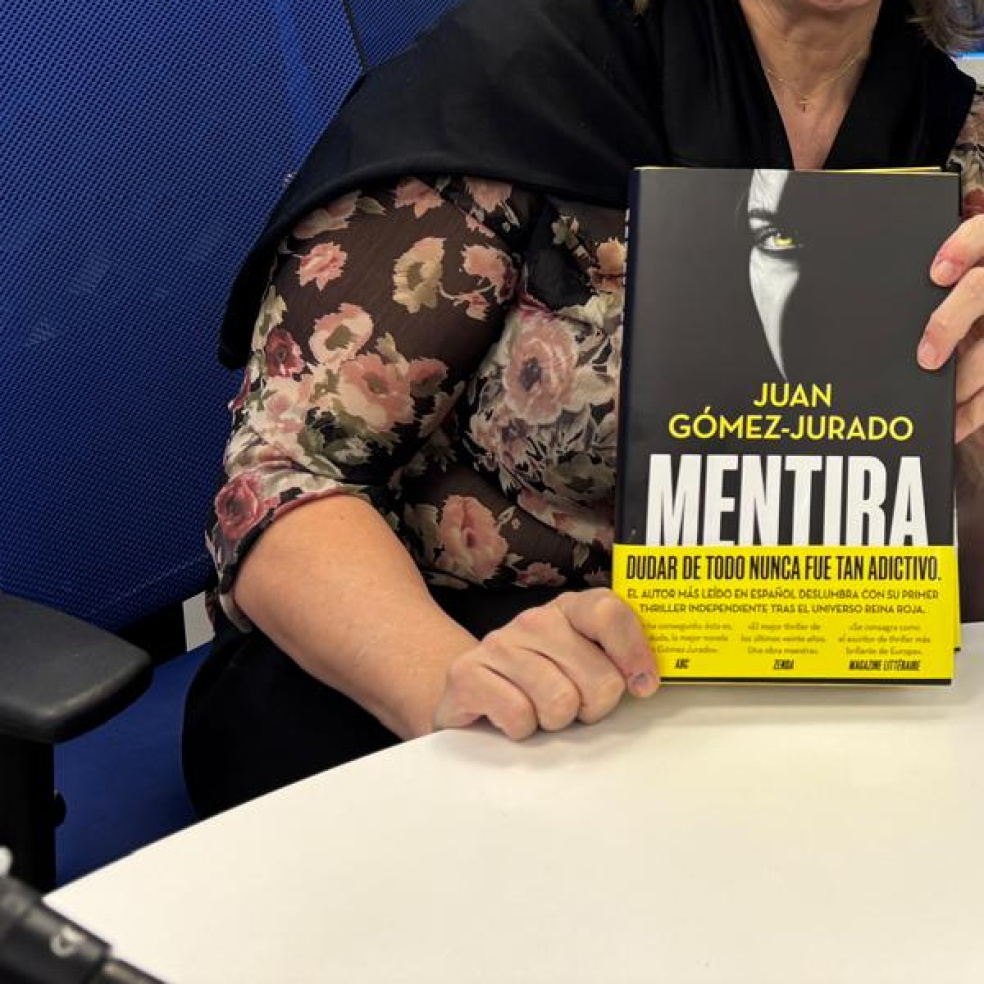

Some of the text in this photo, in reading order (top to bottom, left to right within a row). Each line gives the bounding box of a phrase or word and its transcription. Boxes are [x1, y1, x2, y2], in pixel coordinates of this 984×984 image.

[752, 382, 832, 408] JUAN
[668, 405, 914, 442] GÓMEZ-JURADO
[645, 453, 929, 546] MENTIRA
[626, 555, 941, 581] DUDAR DE TODO NUNCA FUE TAN ADICTIVO.
[627, 585, 939, 600] EL AUTOR MÁS LEÍDO EN ESPAÑOL DESLUMBRA CON SU PRIMER
[640, 603, 926, 614] THRILLER INDEPENDIENTE TRAS EL UNIVERSO REINA ROJA.
